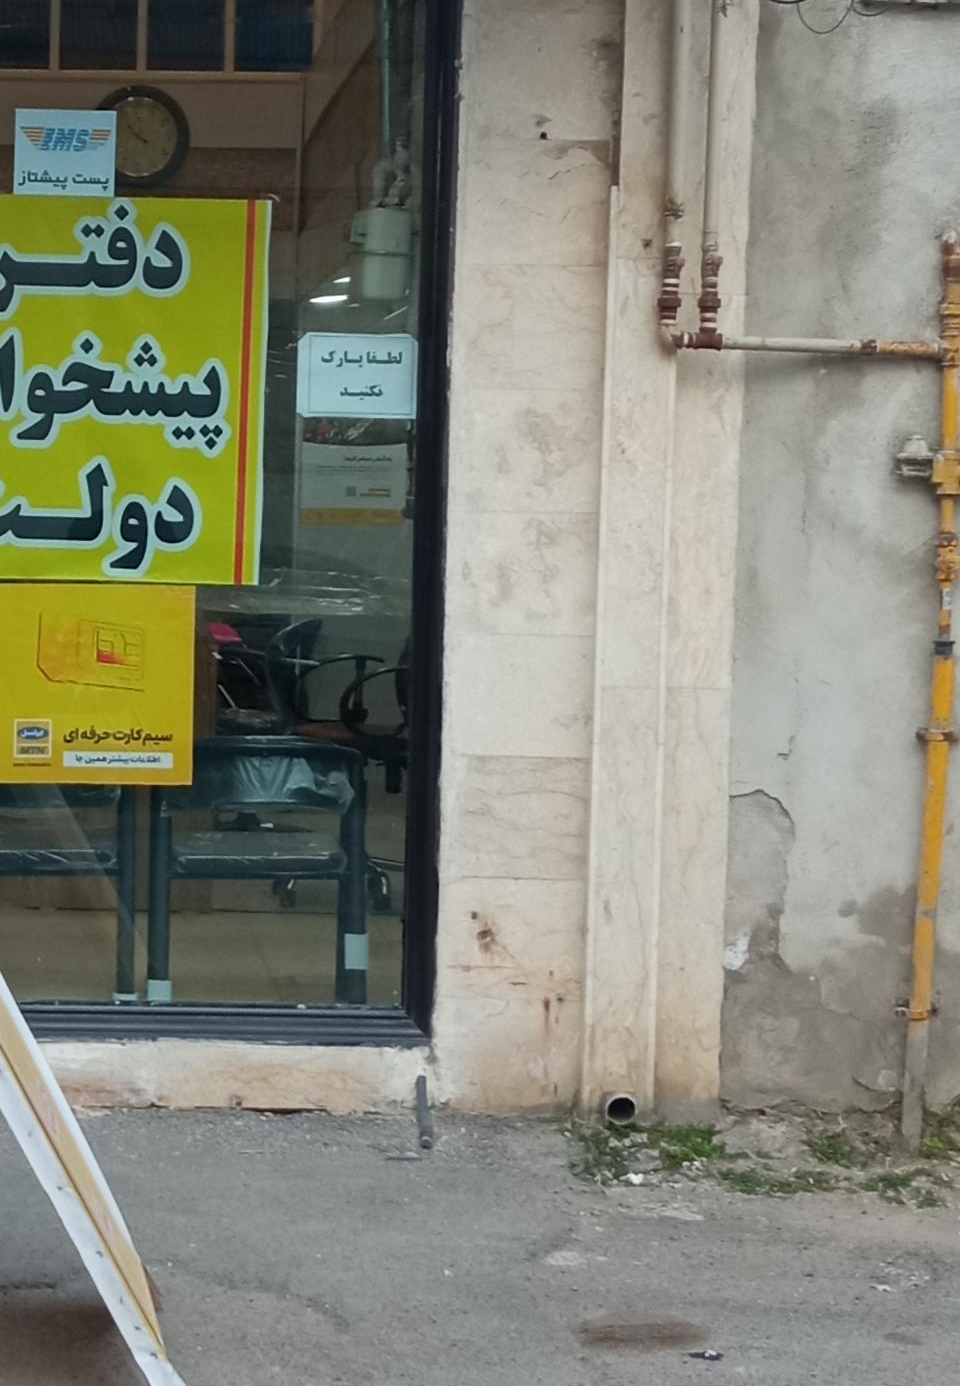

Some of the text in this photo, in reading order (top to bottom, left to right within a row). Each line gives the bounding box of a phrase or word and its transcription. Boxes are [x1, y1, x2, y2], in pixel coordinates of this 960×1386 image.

[40, 127, 90, 152] EMS
[17, 169, 110, 191] پست پیشتاز
[321, 350, 403, 369] لطفا پارک
[339, 384, 384, 401] نکنید
[63, 727, 80, 744] ای
[112, 727, 144, 745] کارت
[142, 732, 174, 747] سیم
